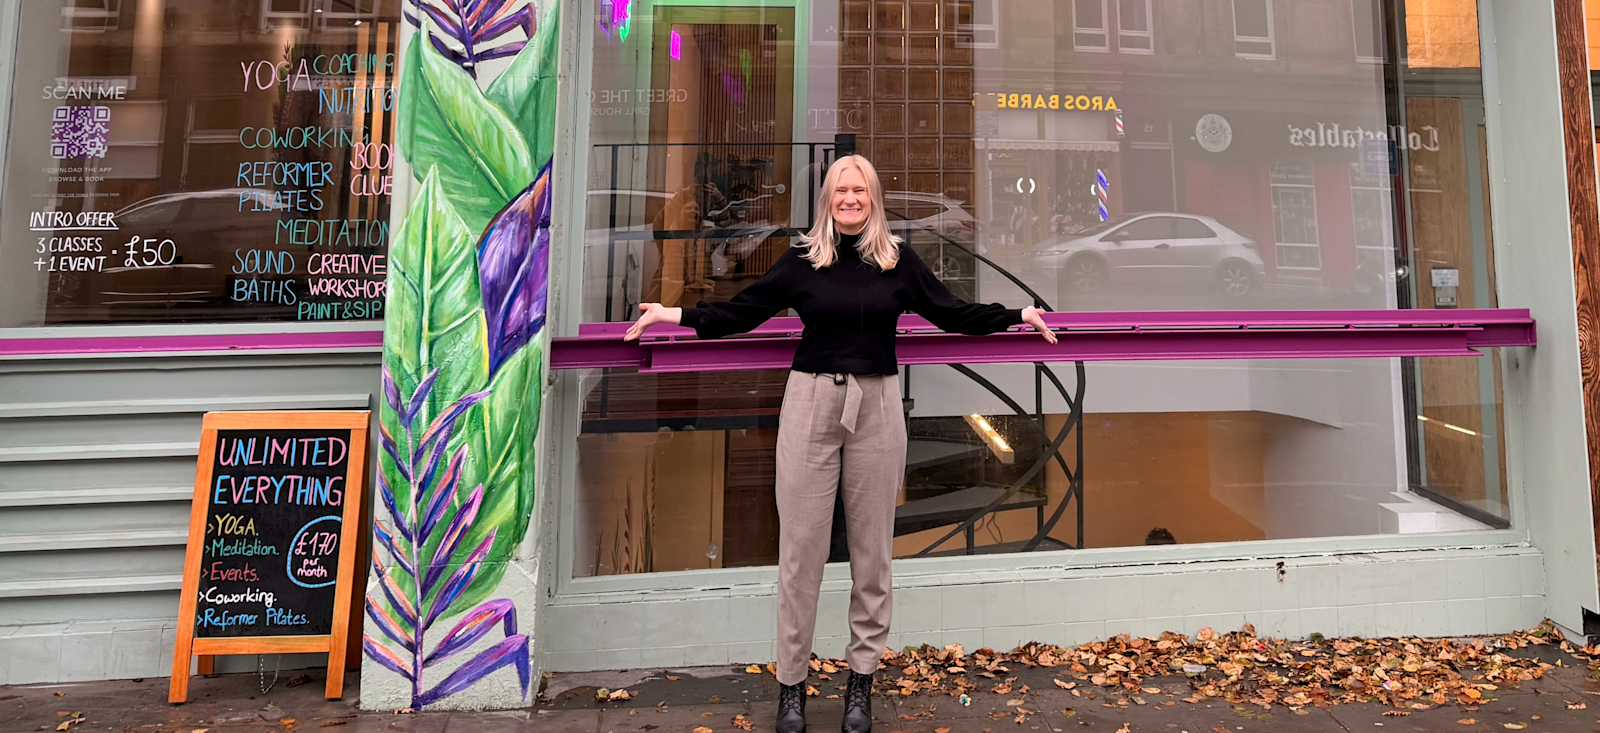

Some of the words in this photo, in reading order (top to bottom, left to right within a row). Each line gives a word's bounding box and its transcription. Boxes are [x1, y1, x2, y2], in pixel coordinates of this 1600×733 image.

[240, 58, 312, 92] YOGA
[313, 53, 395, 75] COACHING
[42, 86, 92, 99] SCAN
[98, 86, 125, 99] ME
[239, 126, 369, 149] COWORKING
[237, 161, 335, 187] REFORMER
[238, 189, 324, 212] PILATES
[29, 212, 73, 228] INTRO
[76, 212, 117, 228] OFFER
[275, 218, 390, 247] MEDITATION
[36, 238, 46, 253] 3
[48, 237, 103, 253] CLASSES
[124, 235, 177, 268] £50
[59, 255, 107, 273] EVENT
[231, 248, 295, 275] SOUND
[307, 253, 387, 275] CREATIVE
[230, 278, 297, 306] BATHS
[298, 301, 342, 321] PAINT
[353, 301, 382, 319] SIP
[219, 436, 347, 467] UNLIMITED
[214, 475, 343, 506] EVERYTHING
[211, 538, 280, 558] Meditation.
[294, 532, 338, 556] £170
[210, 562, 260, 582] Events.
[297, 565, 328, 578] month
[303, 558, 320, 569] per
[205, 587, 277, 608] Coworking.
[203, 608, 258, 631] Reformer
